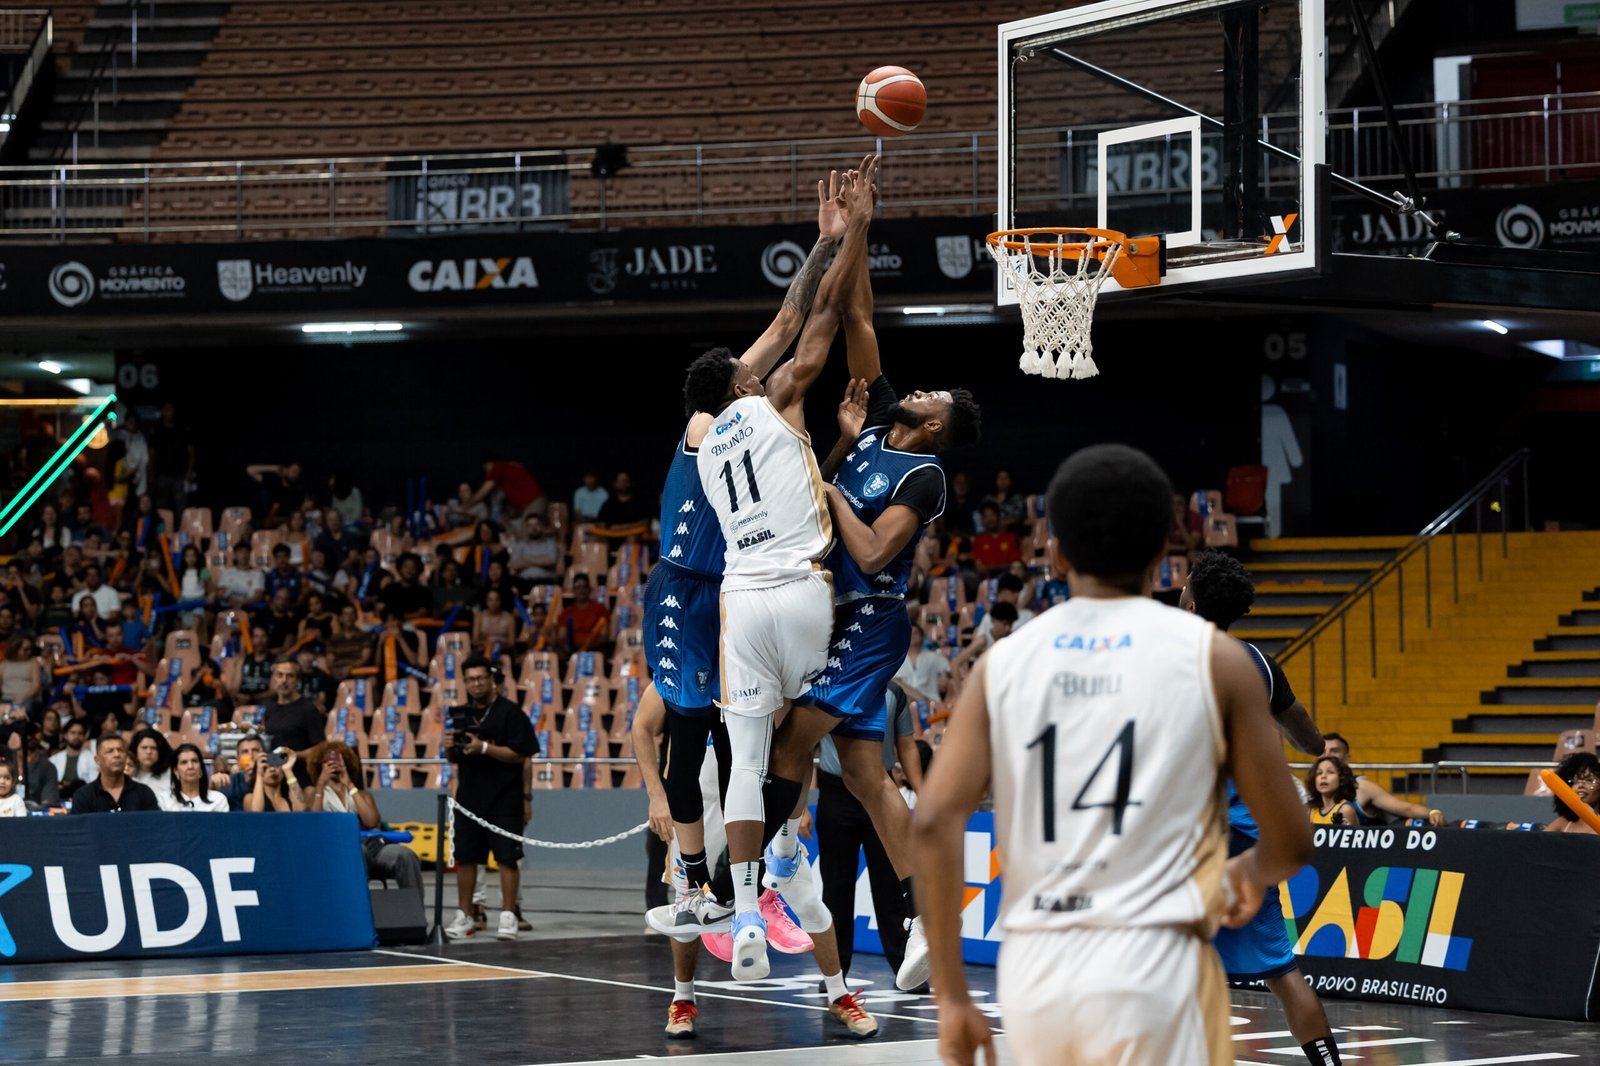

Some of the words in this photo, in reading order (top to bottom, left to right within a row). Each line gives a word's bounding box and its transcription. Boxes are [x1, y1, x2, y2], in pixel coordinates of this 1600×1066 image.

[625, 244, 718, 277] JADE
[100, 276, 186, 291] MOVIMENTO
[255, 260, 367, 288] Heavenly
[408, 257, 539, 292] CAIXA
[1264, 333, 1307, 359] 05
[119, 364, 159, 389] 06
[715, 411, 743, 436] CAIXA
[719, 448, 762, 514] 11
[737, 510, 768, 528] Heavenly
[736, 529, 776, 551] BRASIL
[1054, 633, 1134, 653] CAIXA
[739, 686, 762, 698] JADE
[1026, 719, 1142, 843] 14
[1313, 828, 1395, 849] OVERNO
[1406, 830, 1437, 851] DO
[44, 857, 260, 953] UDF
[1278, 865, 1473, 972] RASIL
[1316, 975, 1357, 992] POVO
[1361, 978, 1447, 1004] BRASILEIRO
